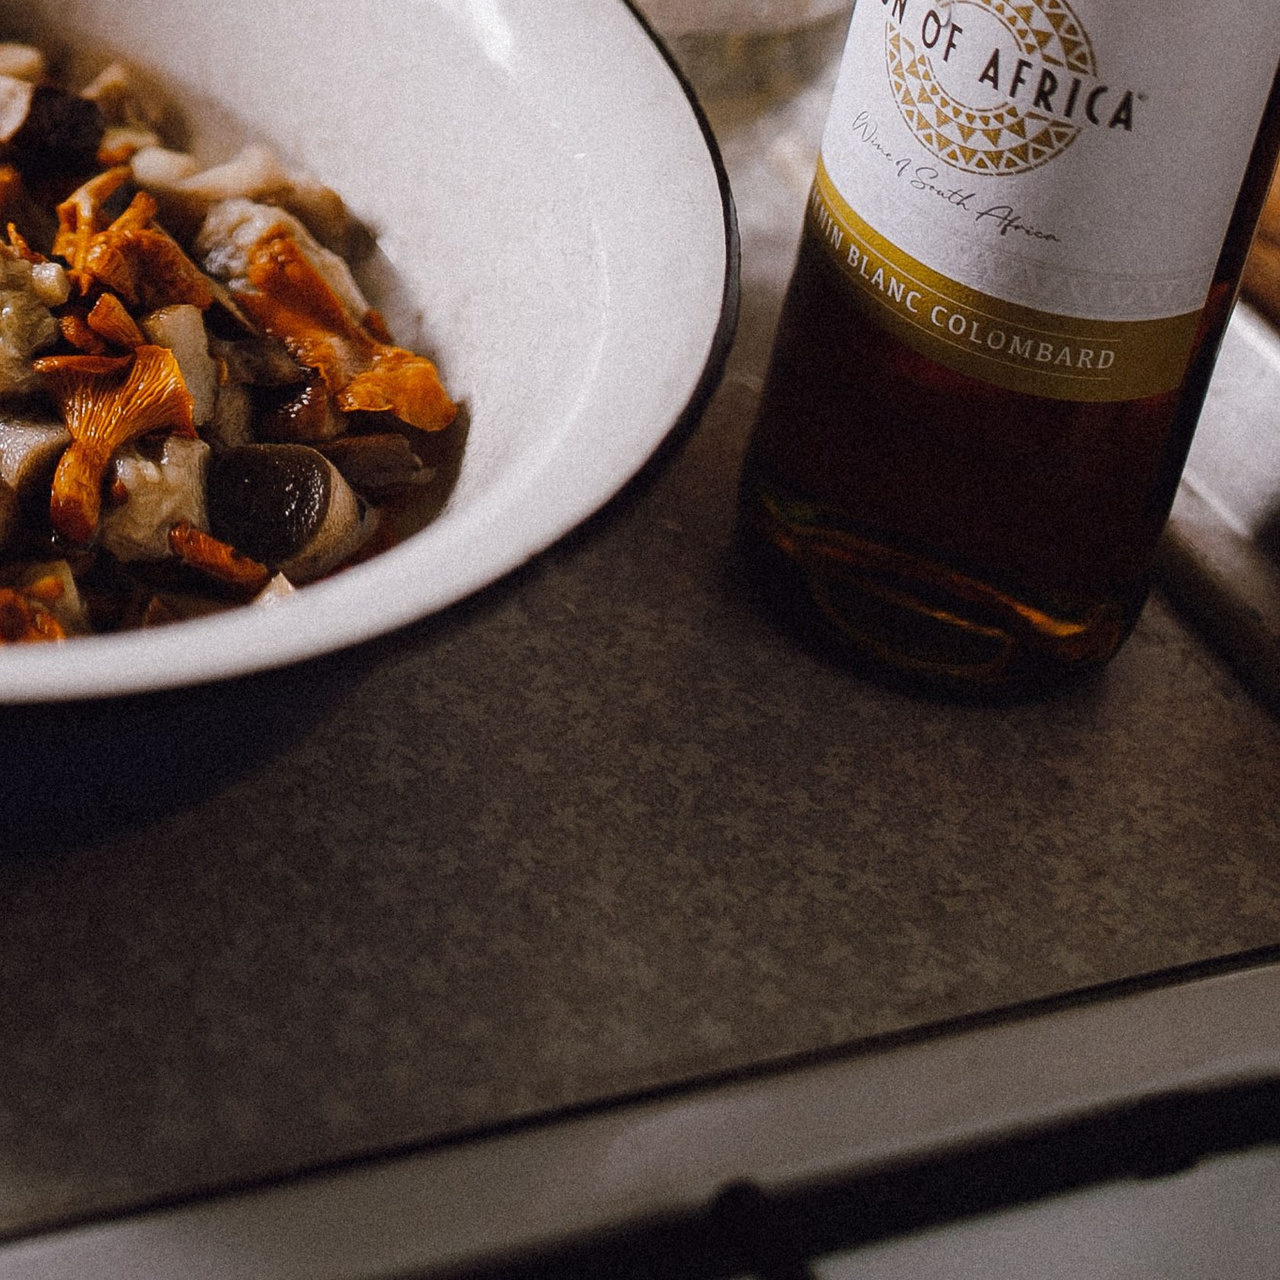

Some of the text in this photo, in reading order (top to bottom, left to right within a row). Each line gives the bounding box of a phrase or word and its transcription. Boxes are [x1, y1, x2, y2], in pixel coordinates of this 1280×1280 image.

[922, 9, 963, 62] OF
[978, 48, 1135, 132] AFRICA
[852, 110, 893, 162] Wine
[910, 166, 976, 211] South
[975, 205, 1062, 242] Africa
[847, 243, 922, 313] BLANC
[930, 304, 1116, 370] COLOMBARD
